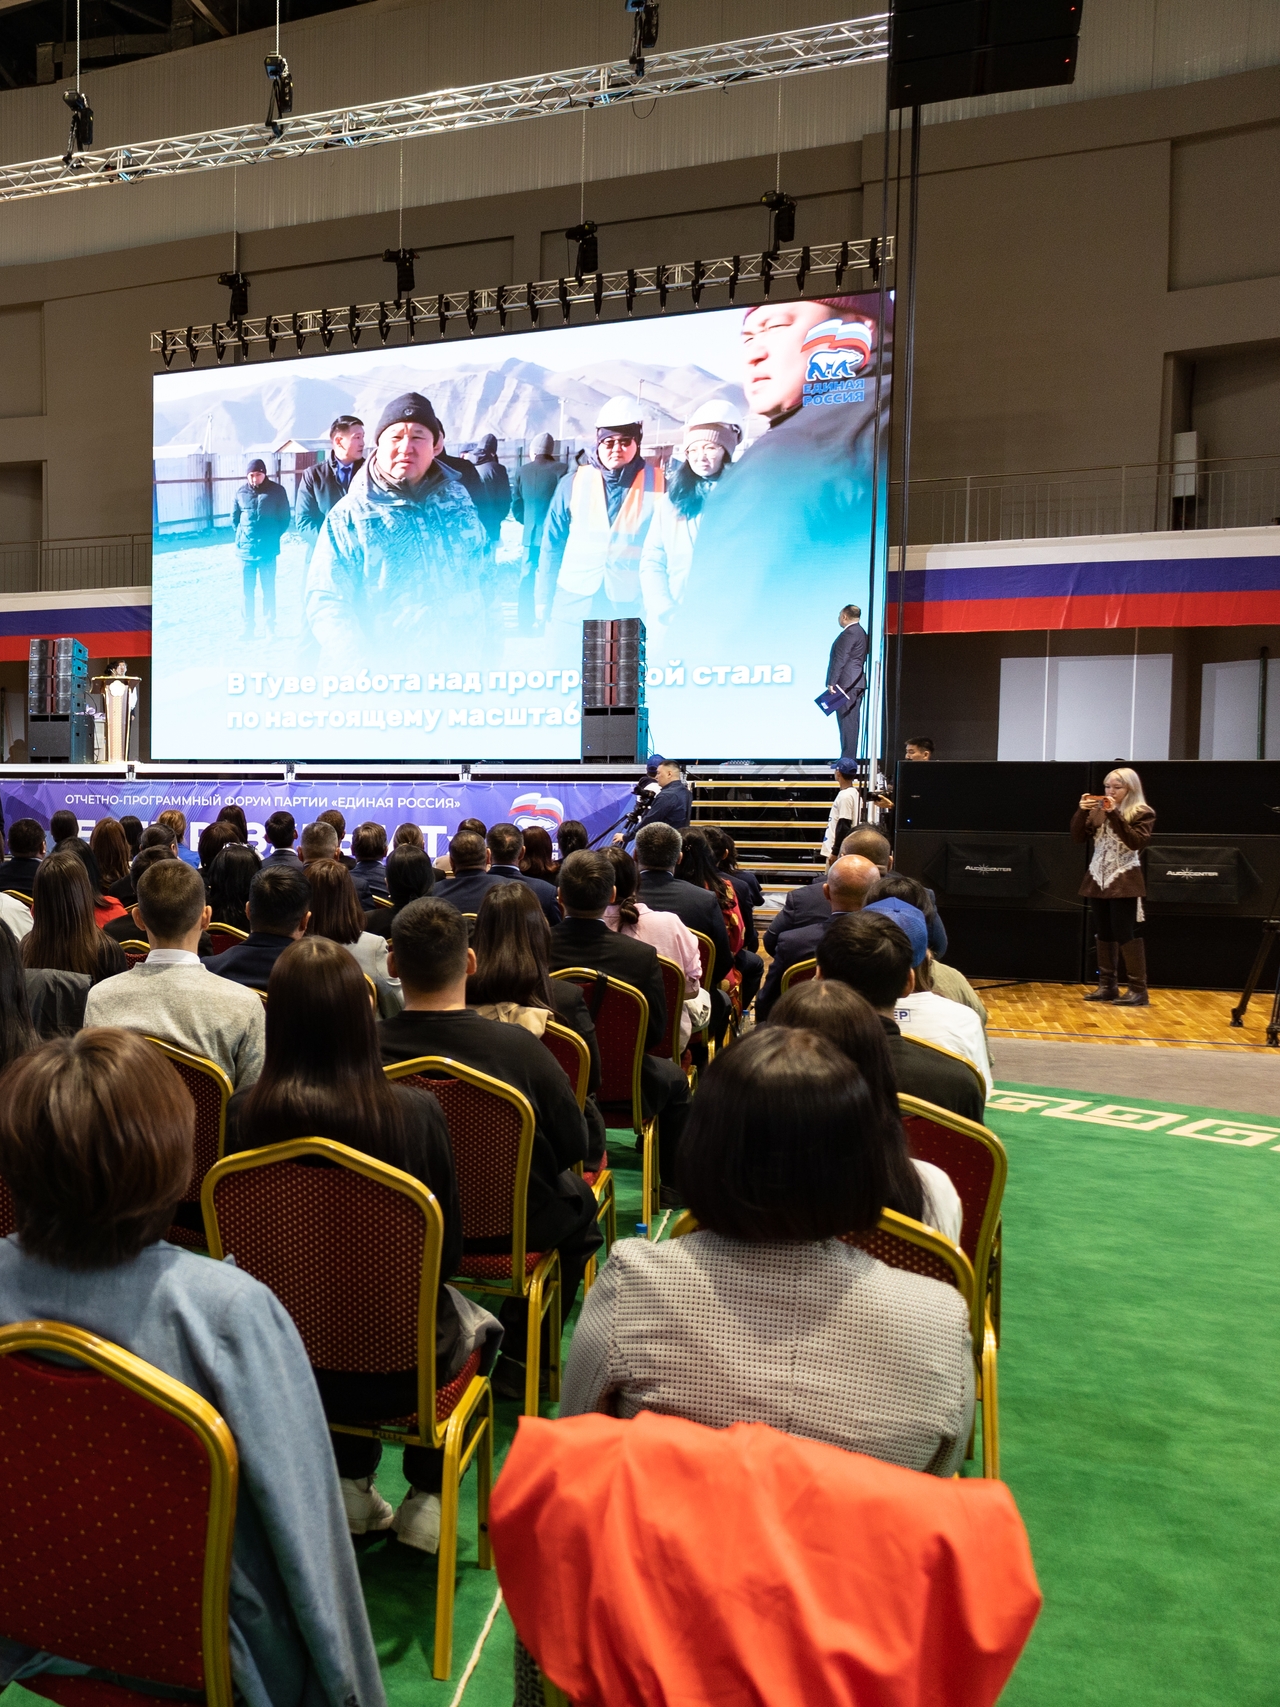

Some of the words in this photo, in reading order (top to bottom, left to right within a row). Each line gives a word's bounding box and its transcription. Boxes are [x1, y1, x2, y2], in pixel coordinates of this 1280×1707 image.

[803, 379, 865, 395] ЕДИНАЯ
[803, 390, 865, 407] РОССИЯ
[227, 672, 246, 695] В
[251, 671, 317, 699] Туве
[322, 668, 421, 698] работа
[427, 671, 482, 693] над
[488, 660, 685, 695] прогрой
[692, 663, 793, 686] стала
[226, 710, 260, 729] по
[265, 708, 442, 732] настоящему
[65, 794, 221, 807] ОТЧЕТНО-ПРОГРАММНЫЙ
[224, 795, 271, 807] ФОРУМ
[274, 797, 328, 808] ПАРТИИ
[331, 797, 394, 809] «ЕДИНАЯ
[397, 797, 461, 809] РОССИЯ»
